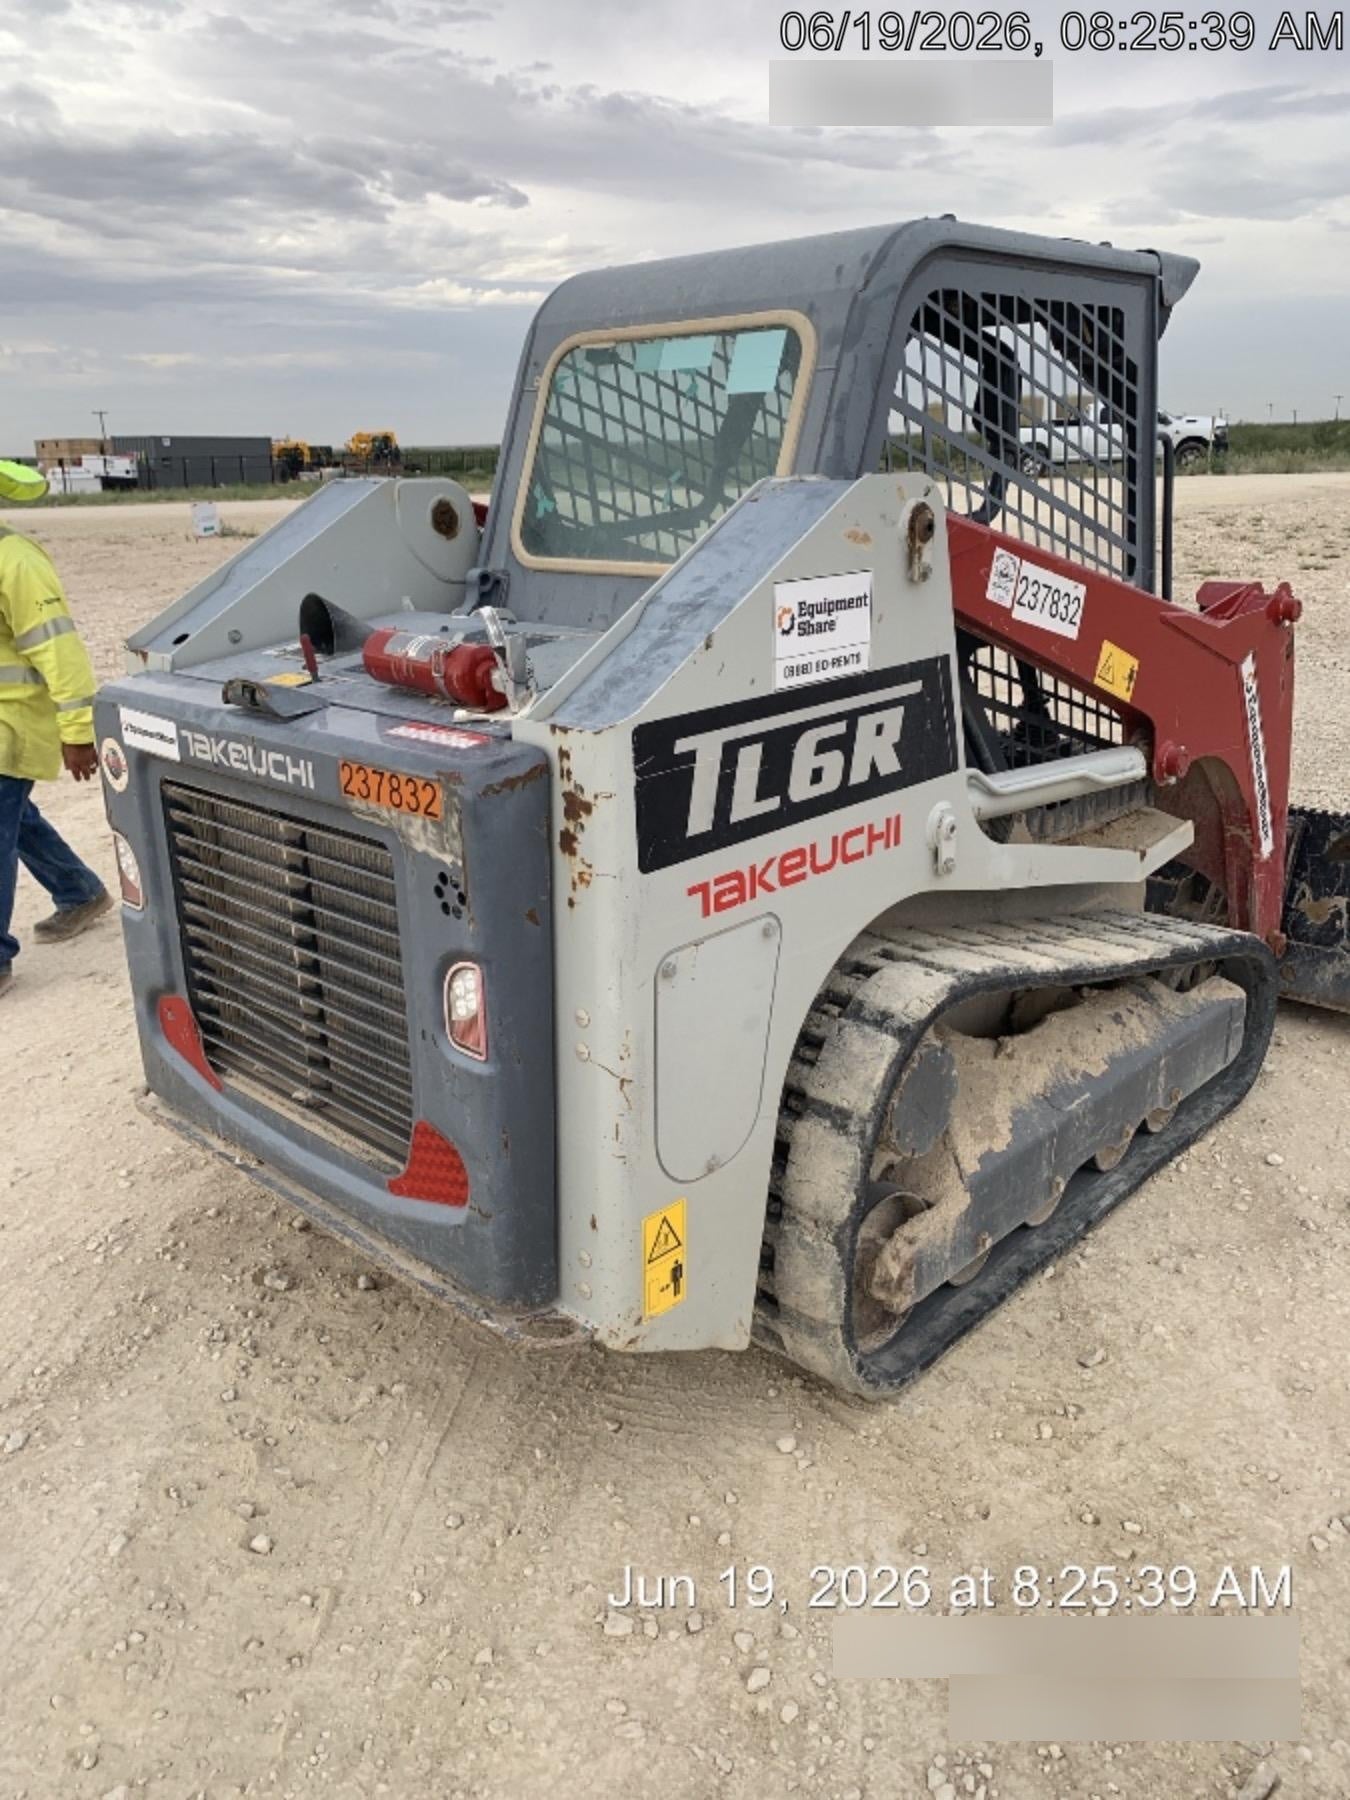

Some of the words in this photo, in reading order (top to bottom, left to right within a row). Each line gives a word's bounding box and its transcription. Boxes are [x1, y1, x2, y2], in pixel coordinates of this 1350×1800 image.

[797, 592, 868, 619] Equipment
[797, 619, 836, 637] Share
[1016, 575, 1081, 626] 237832
[180, 729, 314, 790] TAKEUCHI
[673, 680, 923, 838] TL6R
[341, 762, 439, 818] 237832
[687, 813, 902, 918] TAKEUCHI
